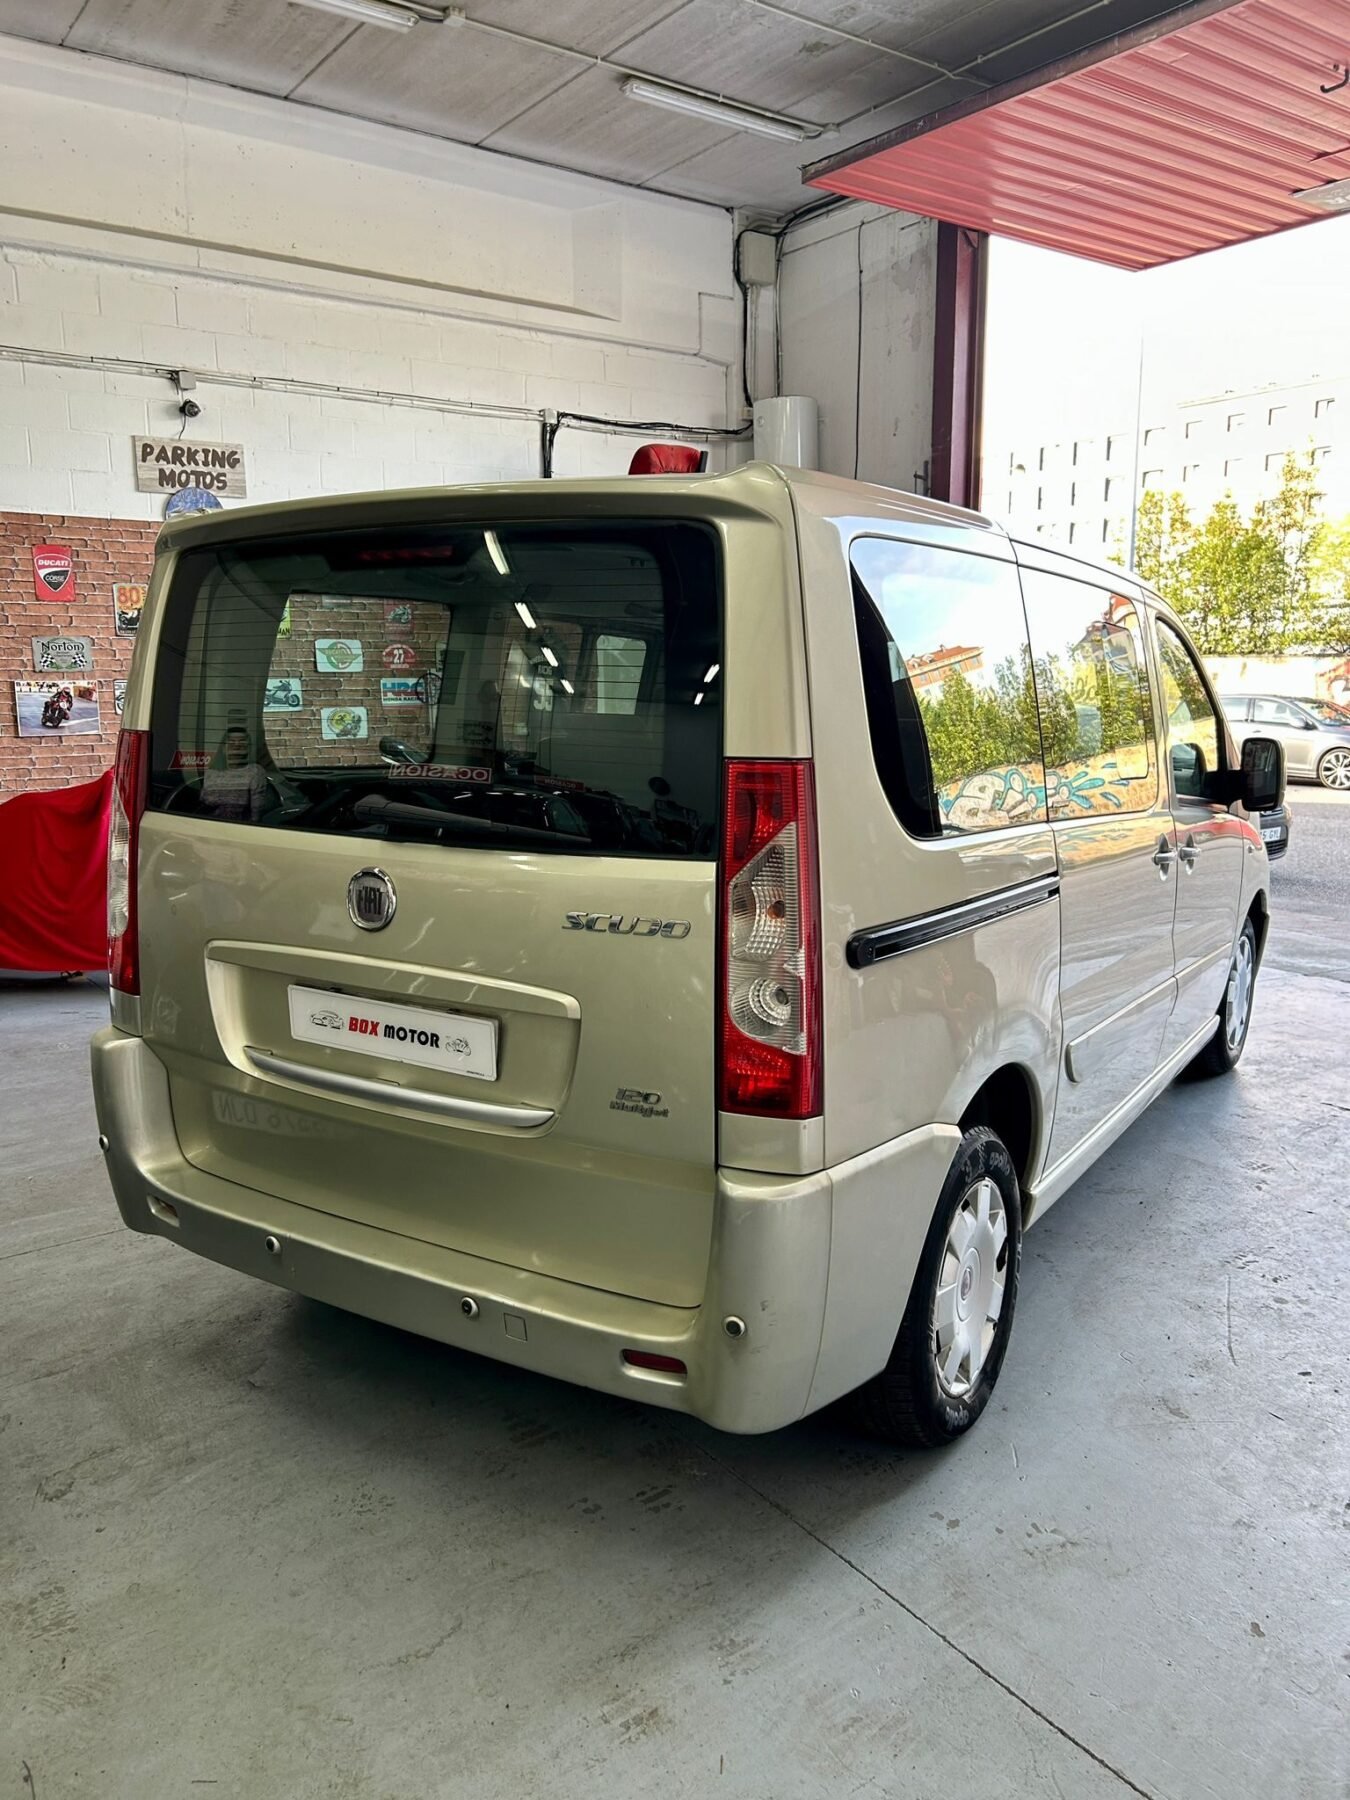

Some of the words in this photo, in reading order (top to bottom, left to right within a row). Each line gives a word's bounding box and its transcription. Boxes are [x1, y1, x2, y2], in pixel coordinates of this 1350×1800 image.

[141, 443, 241, 469] PARKING
[158, 468, 228, 491] MOTOS
[38, 559, 69, 567] DUCATI
[45, 574, 65, 582] CORSE
[41, 641, 85, 653] Norton
[393, 649, 405, 664] 27
[562, 911, 691, 939] SCUDO
[349, 1017, 380, 1036] BOX
[384, 1024, 440, 1048] MOTOR
[616, 1088, 661, 1105] 120
